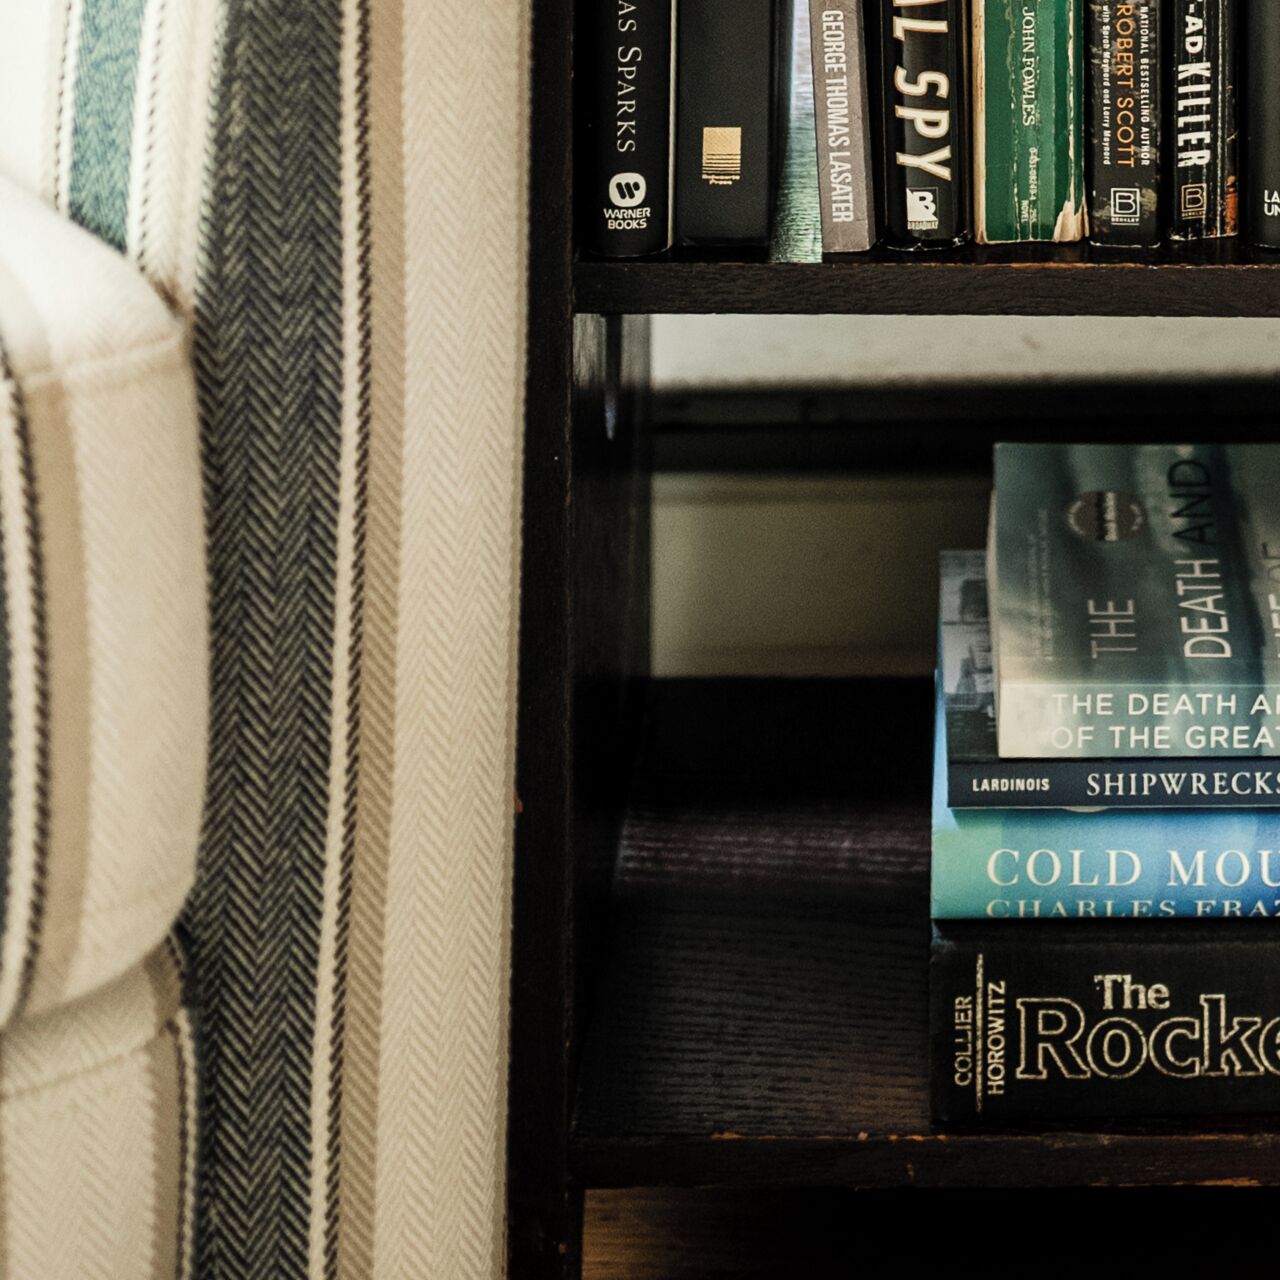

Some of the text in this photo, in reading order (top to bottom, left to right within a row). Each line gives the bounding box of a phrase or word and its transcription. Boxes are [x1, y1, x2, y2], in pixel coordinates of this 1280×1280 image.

[616, 45, 643, 153] SPARKS
[1022, 5, 1037, 128] JOHN FOWLES
[1115, 4, 1135, 168] ROBERT SCOTT
[821, 9, 854, 224] GEORGE THOMAS LASATER
[895, 65, 952, 182] SPY
[1177, 61, 1211, 169] KILLER
[603, 207, 651, 219] WARNER
[607, 218, 648, 230] BOOKS
[1165, 458, 1233, 659] DEATH AND
[1087, 599, 1138, 659] THE
[1053, 693, 1114, 716] THE
[1127, 692, 1237, 715] DEATH
[1053, 725, 1094, 750] OF
[1109, 725, 1171, 749] THE
[972, 778, 1050, 792] LARDINOIS
[986, 848, 1142, 887] COLD
[988, 980, 1006, 1095] HOROWITZ
[1094, 974, 1170, 1011] The
[954, 995, 972, 1086] COLLIER
